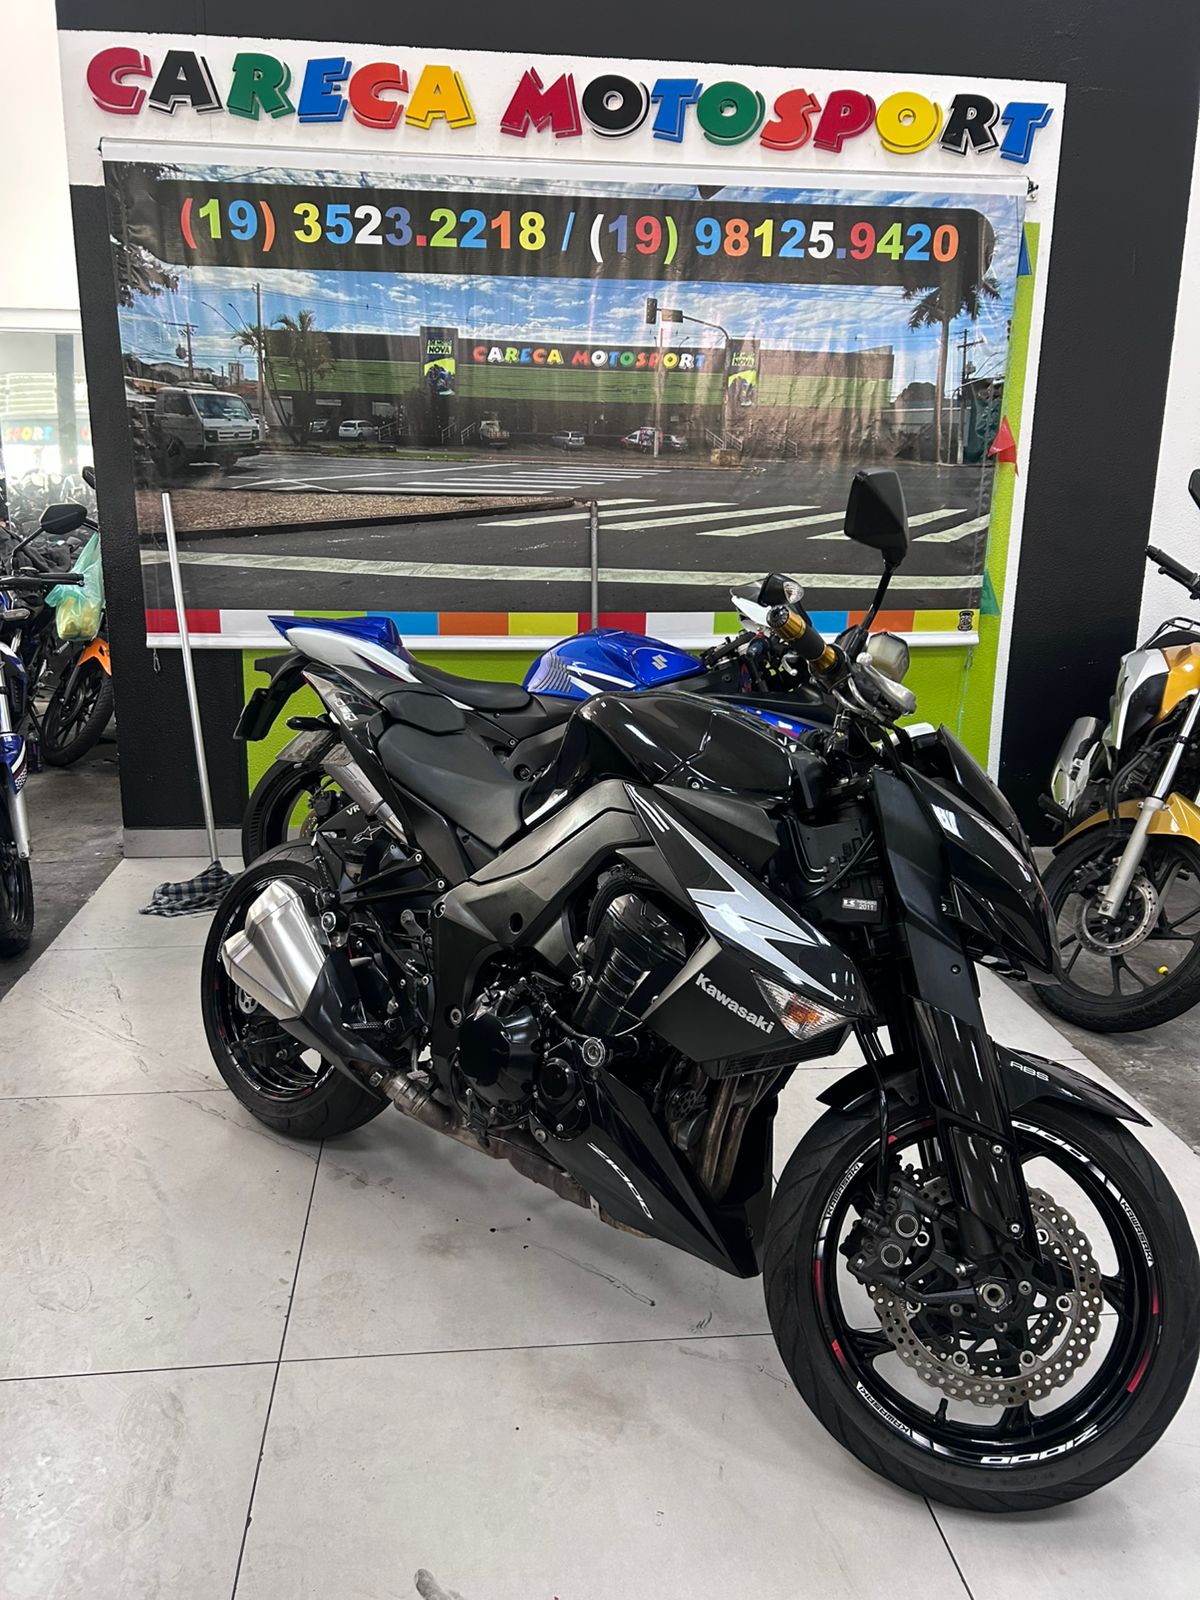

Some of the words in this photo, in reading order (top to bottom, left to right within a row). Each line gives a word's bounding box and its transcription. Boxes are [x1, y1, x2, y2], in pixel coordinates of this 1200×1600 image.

[86, 46, 477, 130] CARECA
[500, 66, 1055, 164] MOTOSPORT
[181, 198, 276, 252] (19)
[293, 202, 546, 251] 3523.2218
[590, 213, 679, 265] (19)
[695, 217, 960, 262] 98125.9420
[428, 345, 451, 354] NOVA
[472, 345, 564, 366] CARECA
[571, 350, 706, 370] MOTOSPORT
[695, 972, 775, 1035] Kawasaki
[1010, 1060, 1049, 1082] ABS
[586, 1142, 655, 1220] Z1000
[826, 1163, 862, 1217] KAWASAKI
[1121, 1200, 1154, 1263] KAWASAKI
[857, 1385, 911, 1435] KAWASAKI
[980, 1424, 1099, 1465] Z1000
